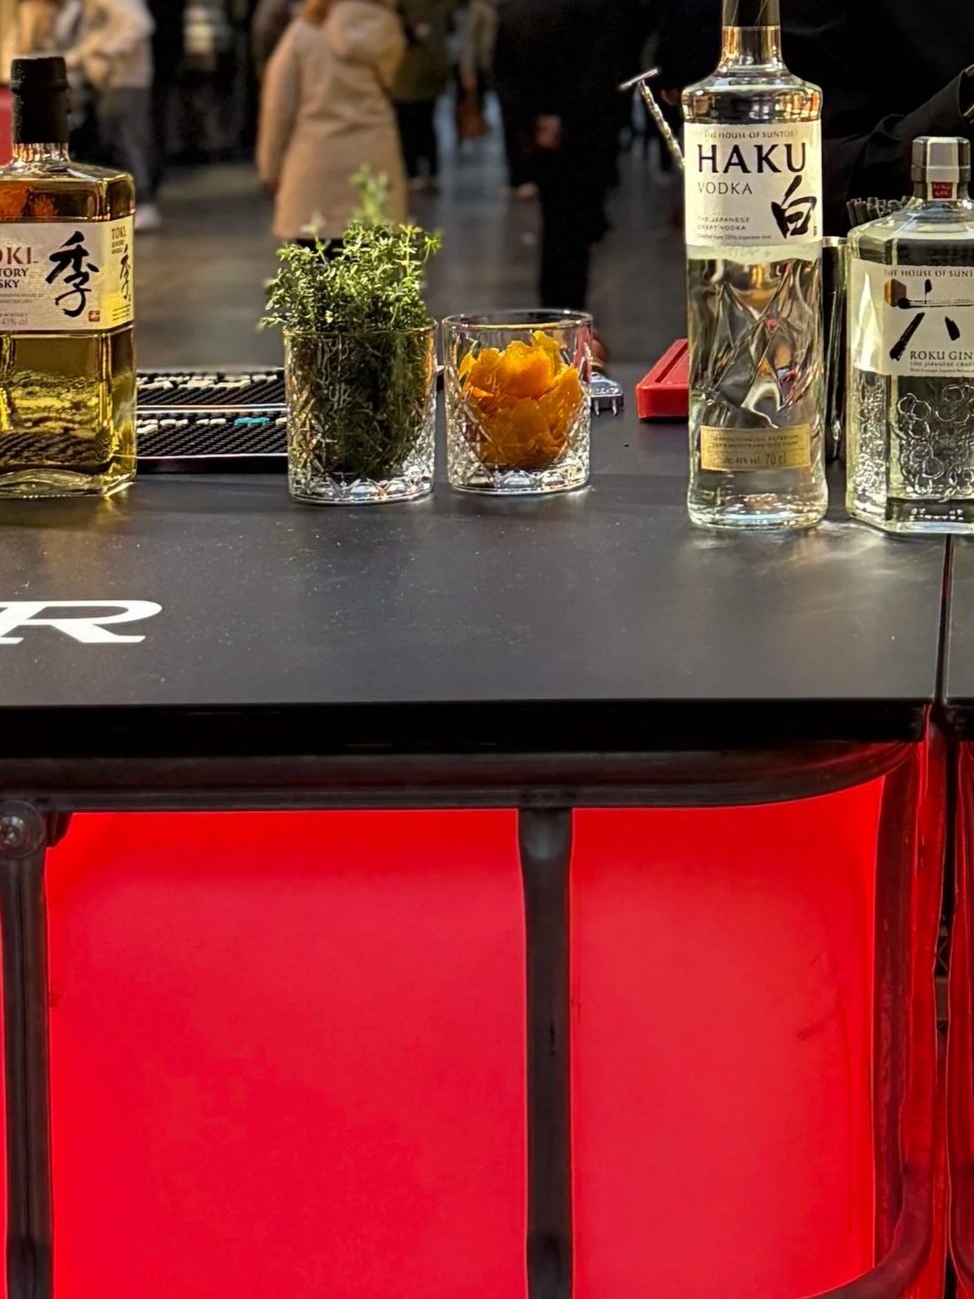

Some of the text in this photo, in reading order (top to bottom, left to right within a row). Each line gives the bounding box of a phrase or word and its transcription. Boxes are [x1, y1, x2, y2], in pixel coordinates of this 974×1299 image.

[719, 131, 747, 140] HOUSE
[748, 130, 761, 139] OF
[697, 142, 806, 173] HAKU
[697, 181, 753, 195] VODKA
[771, 174, 817, 239] 白
[45, 231, 100, 318] 季
[901, 269, 932, 278] HOUSE
[934, 269, 946, 278] OF
[909, 350, 973, 361] ROKU GIN
